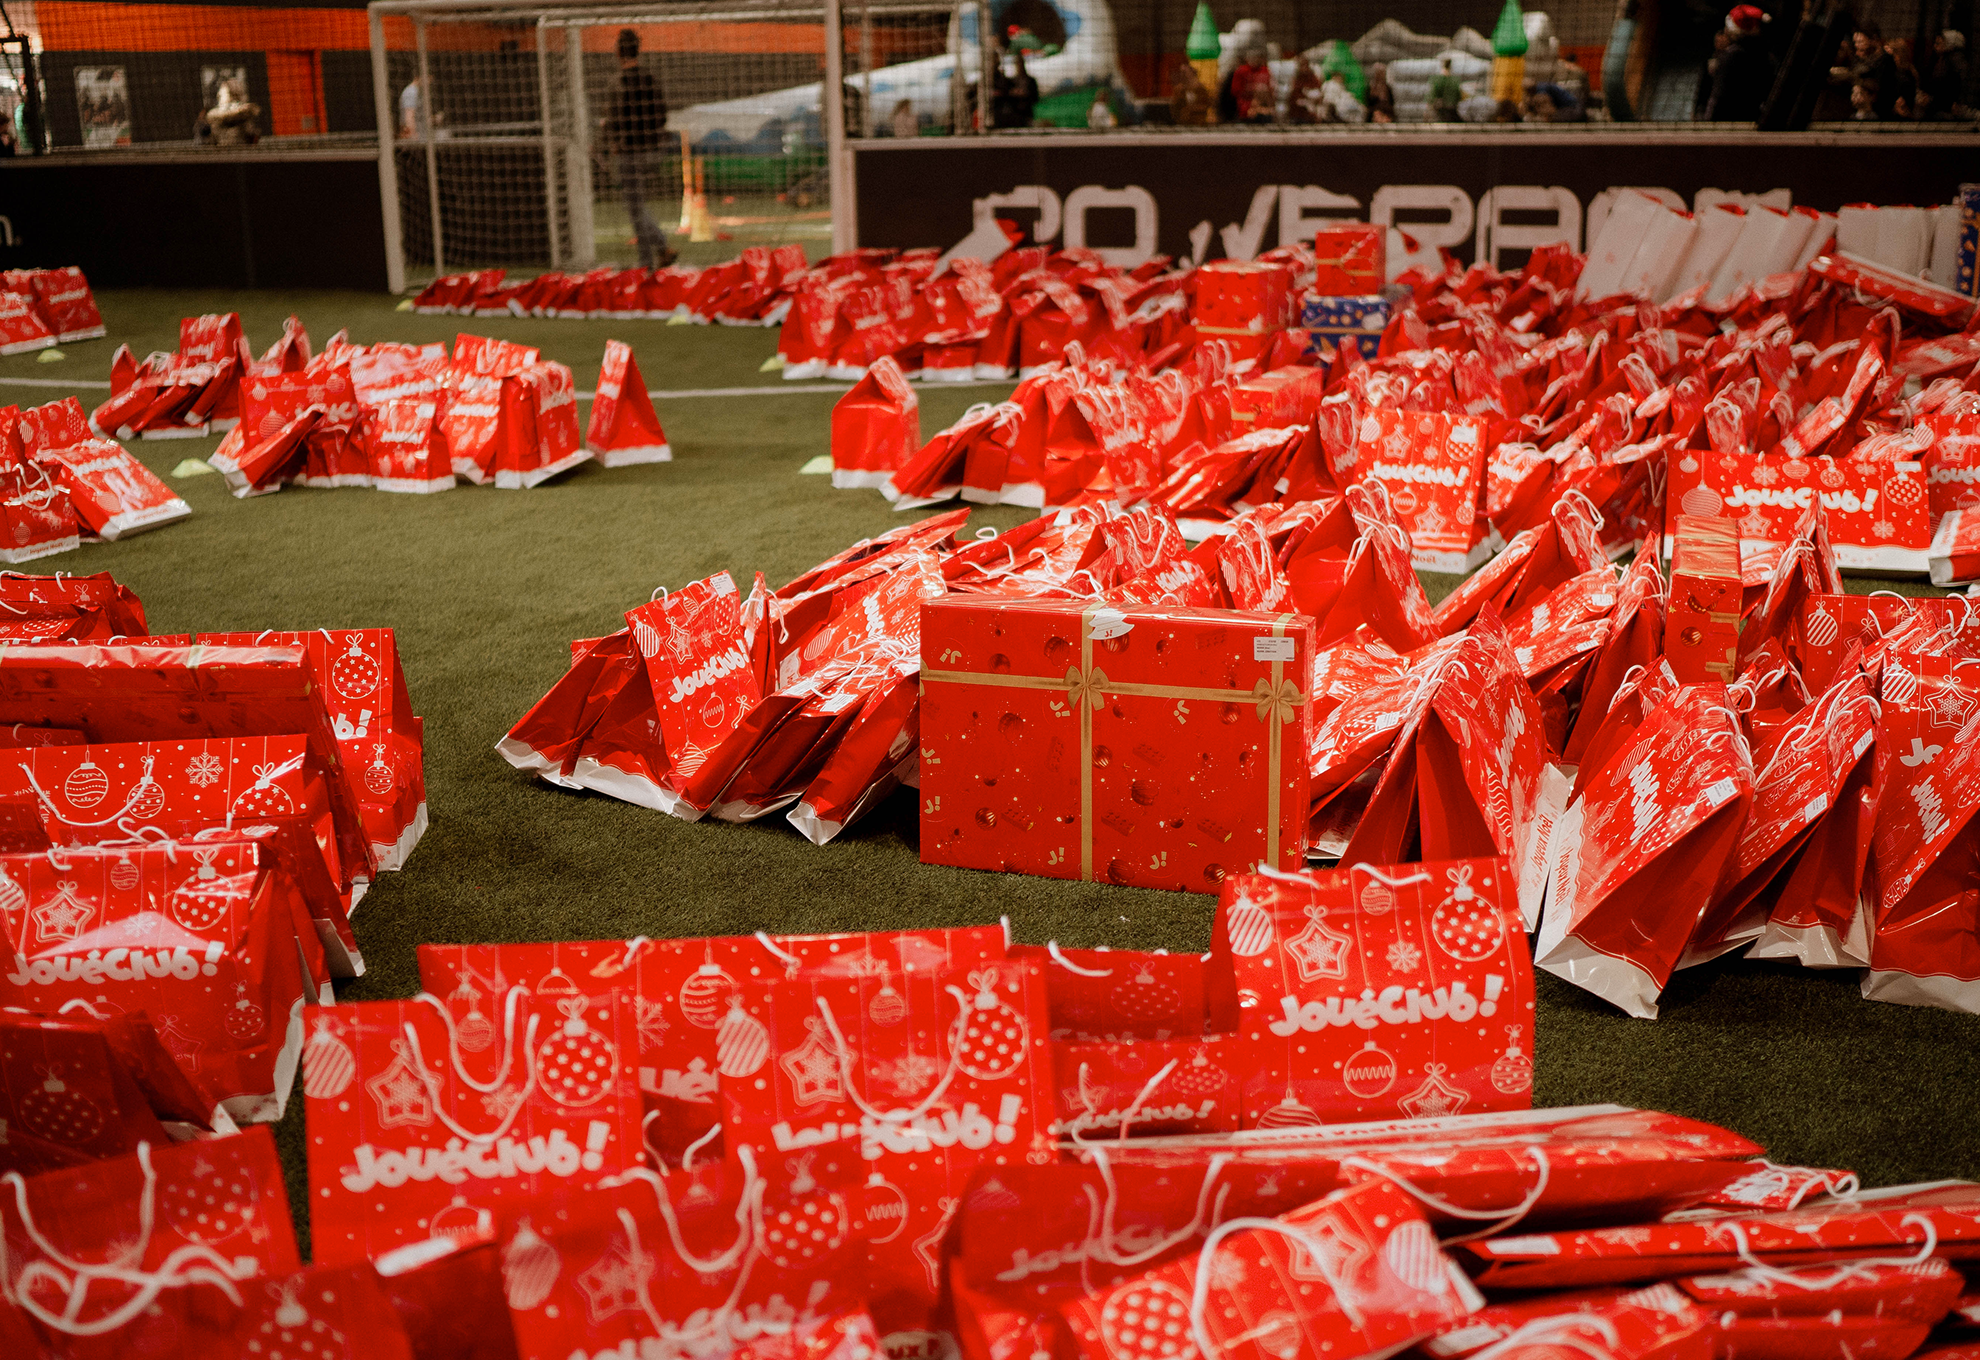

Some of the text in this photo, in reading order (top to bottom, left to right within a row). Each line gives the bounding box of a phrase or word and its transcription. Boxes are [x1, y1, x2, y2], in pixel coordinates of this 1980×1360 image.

[1724, 485, 1879, 513] JouéCub!
[670, 640, 749, 703] JouéClub!
[1530, 813, 1554, 872] Joyeux Noël
[7, 941, 225, 986] JouéClub!
[1268, 974, 1504, 1037] JouéClub!
[341, 1120, 611, 1193] JouéClub!
